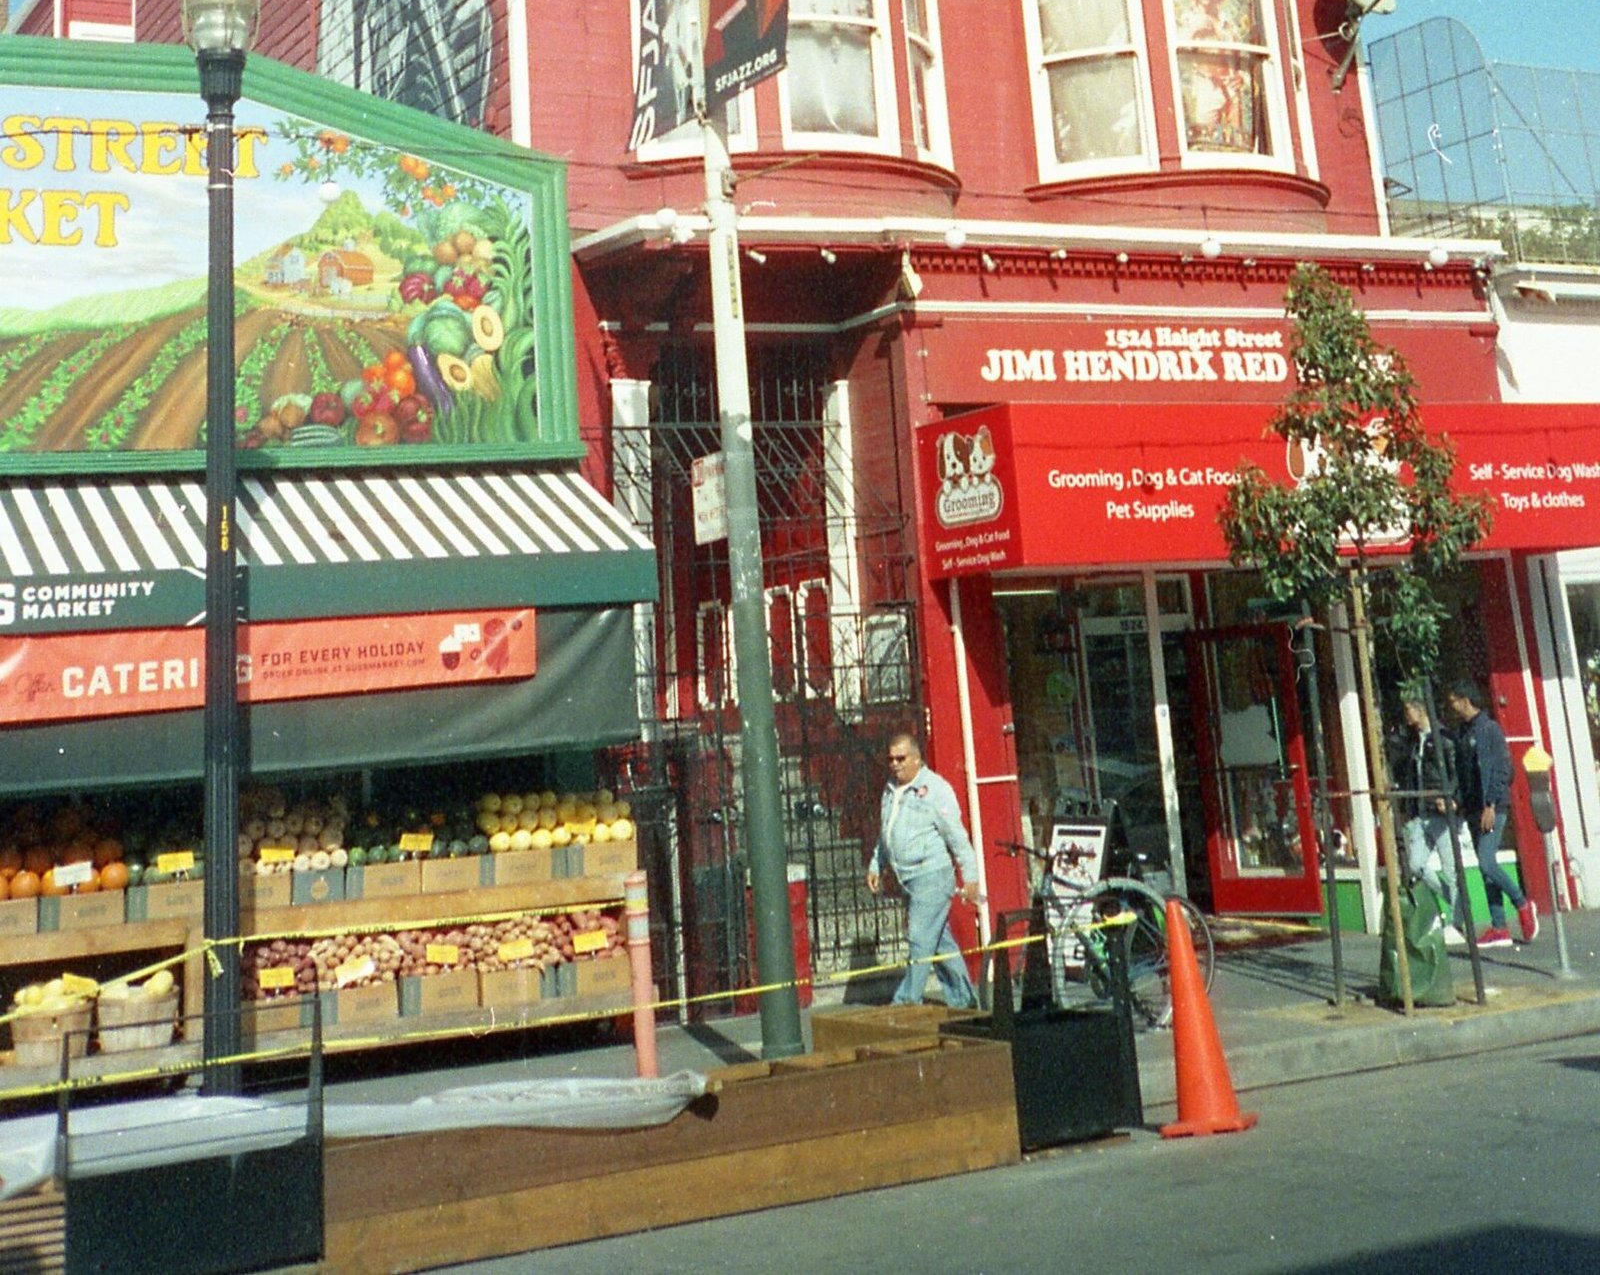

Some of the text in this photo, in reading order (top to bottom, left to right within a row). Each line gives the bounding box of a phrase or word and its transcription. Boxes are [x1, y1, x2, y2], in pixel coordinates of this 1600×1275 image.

[714, 47, 778, 93] SFJAZZ.ORG
[1105, 326, 1283, 352] 1524 Haight Street
[980, 348, 1057, 382] JIMI
[1063, 349, 1218, 382] HENDRIX
[1221, 351, 1289, 383] RED
[1048, 469, 1124, 491] Grooming
[1165, 468, 1177, 486] &
[1179, 467, 1203, 486] Cat
[1469, 463, 1492, 480] Self
[1501, 463, 1544, 480] Service
[1546, 463, 1572, 483] Dog
[1106, 499, 1195, 523] Pet Supplies
[1501, 490, 1585, 513] Toys & clothes
[22, 581, 155, 602] COMMUNITY
[22, 599, 115, 620] MARKET
[62, 654, 253, 699] CATERIG
[261, 652, 292, 667] FOR
[300, 647, 351, 664] EVERY
[358, 641, 424, 659] HOLIDAY
